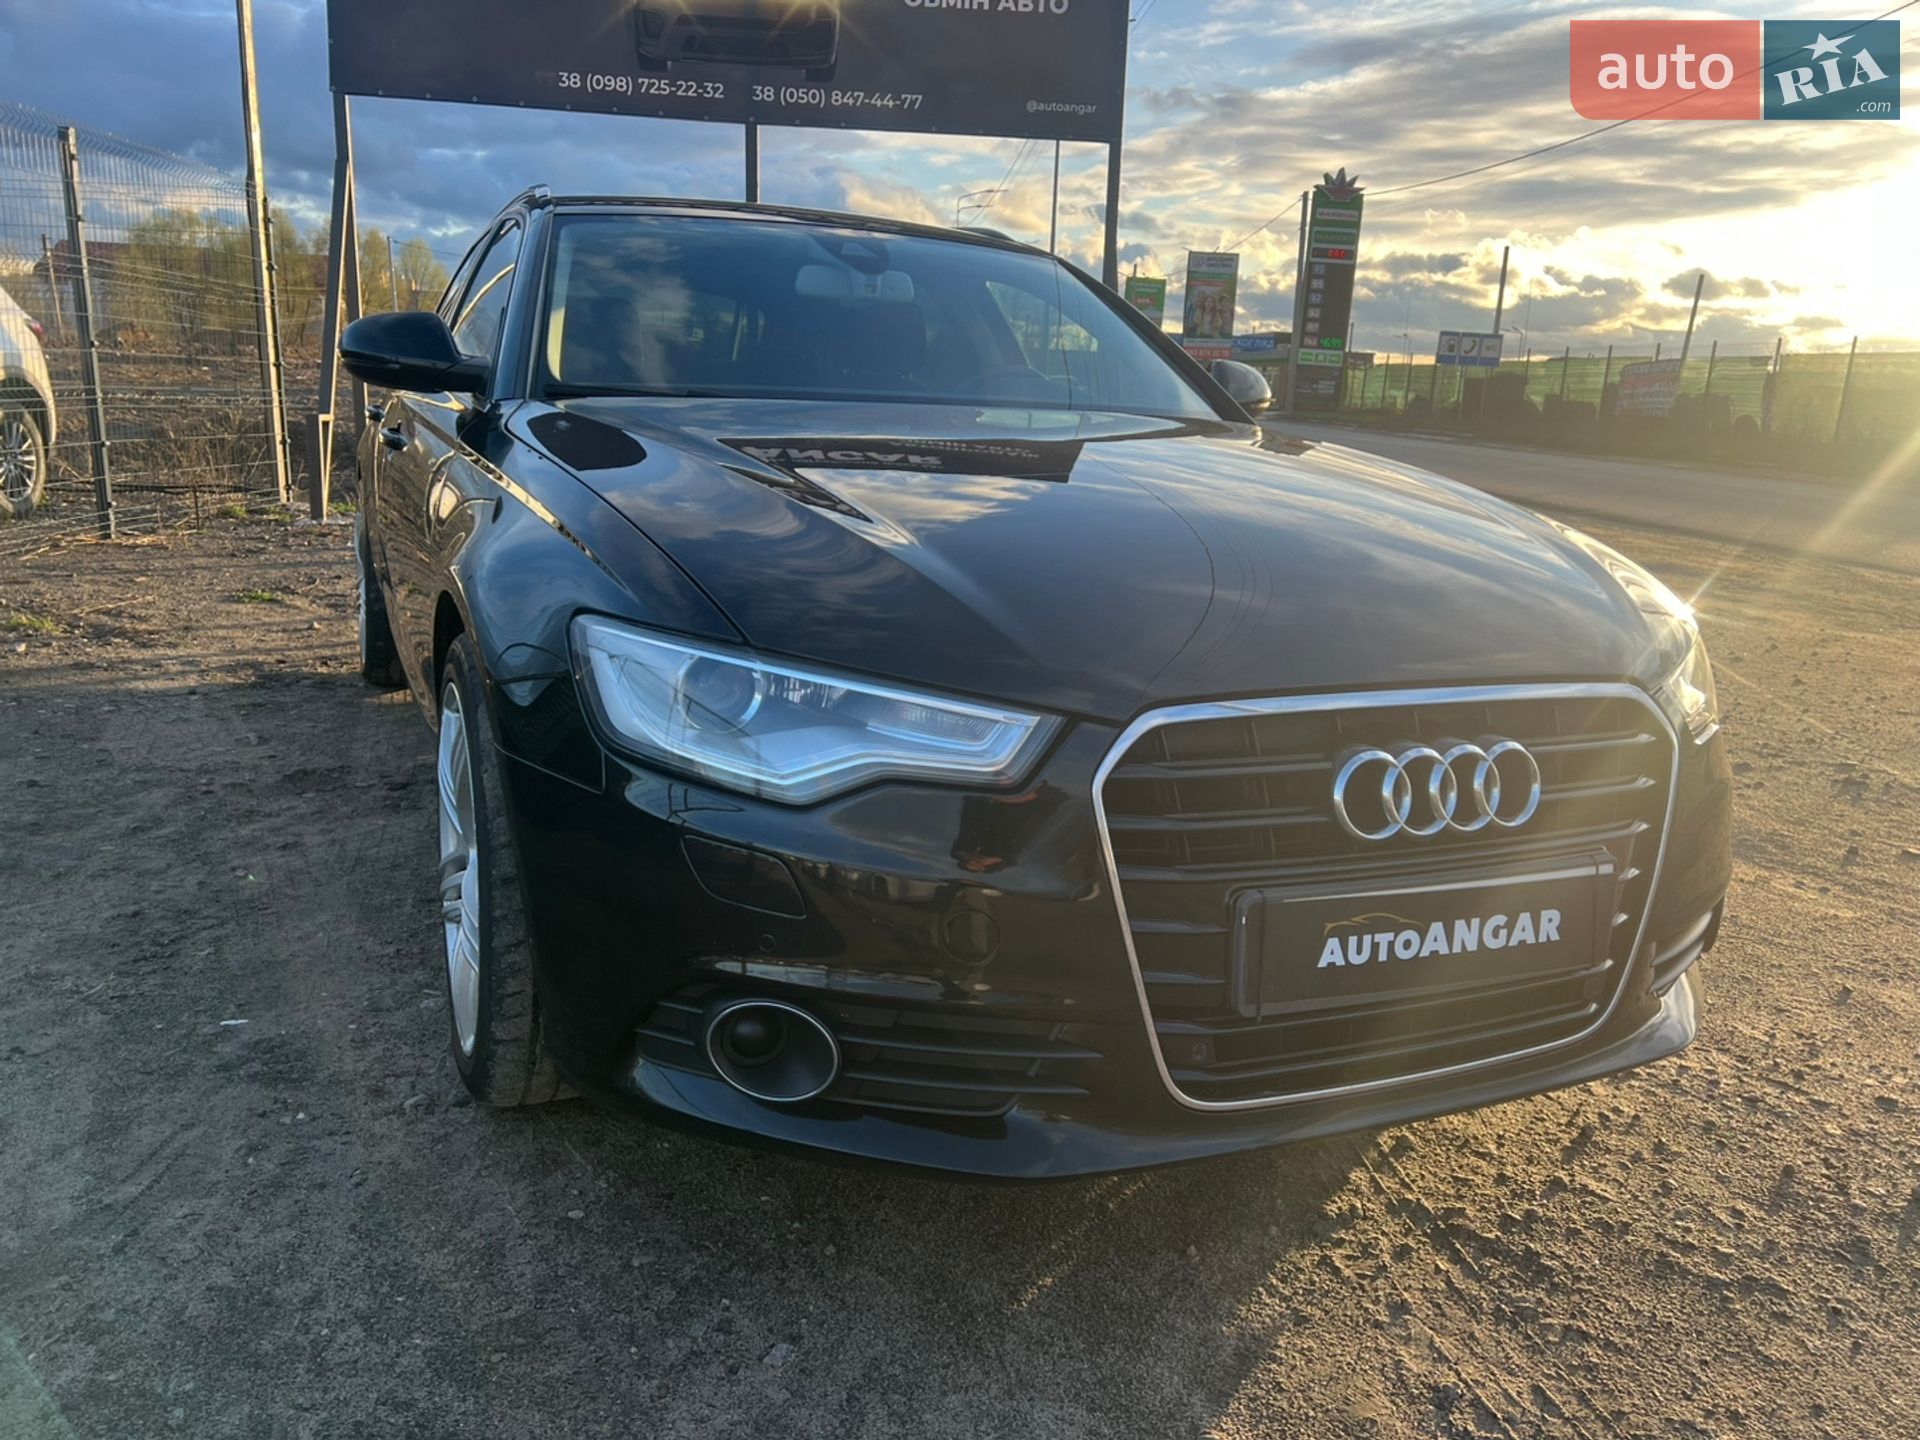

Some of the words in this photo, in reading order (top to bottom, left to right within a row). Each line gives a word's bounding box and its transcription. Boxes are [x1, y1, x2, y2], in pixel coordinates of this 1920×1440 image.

[558, 71, 582, 88] 38
[586, 73, 633, 96] (098)
[638, 77, 725, 99] 725-22-32
[752, 85, 775, 101] 38
[780, 86, 826, 108] (050)
[831, 90, 923, 110] 847-44-77
[1026, 99, 1097, 116] @autoangar
[1318, 909, 1561, 968] AUTOANGAR
